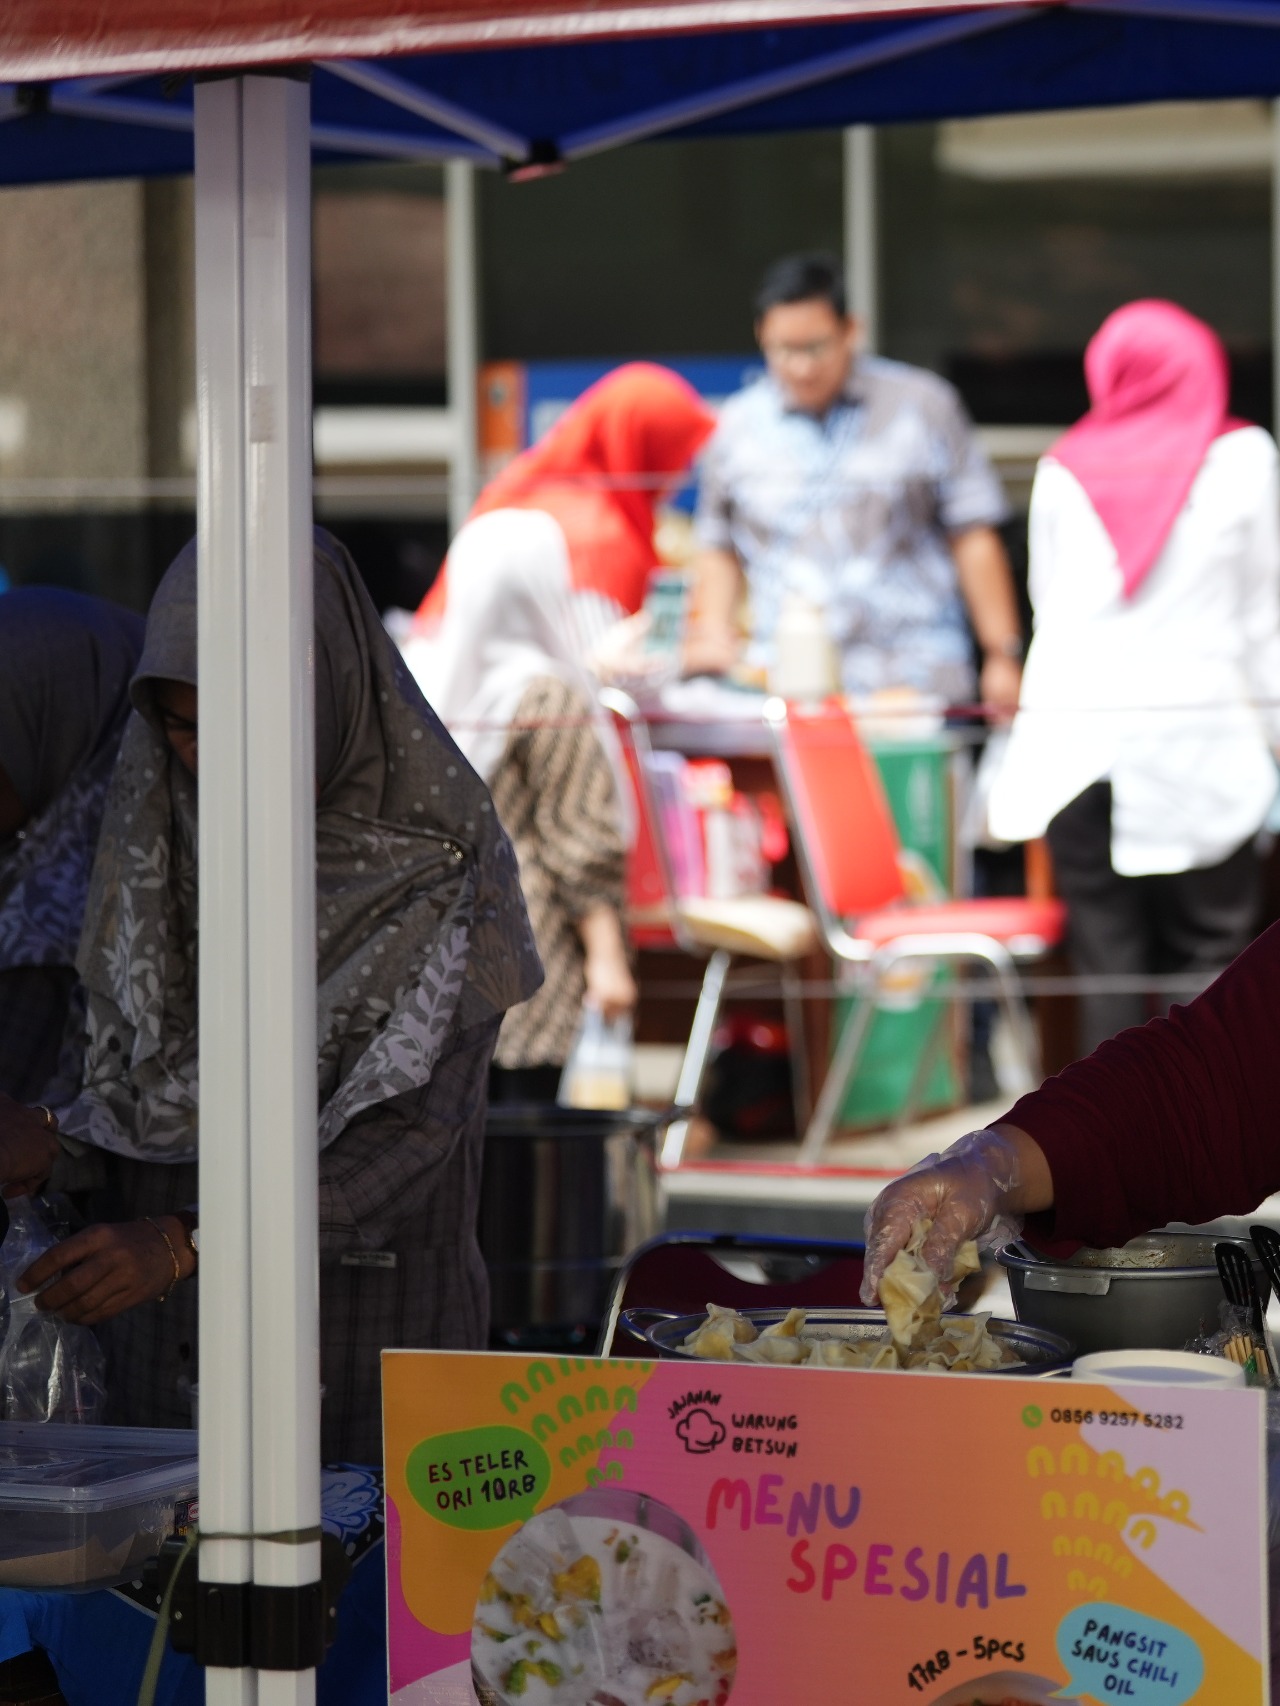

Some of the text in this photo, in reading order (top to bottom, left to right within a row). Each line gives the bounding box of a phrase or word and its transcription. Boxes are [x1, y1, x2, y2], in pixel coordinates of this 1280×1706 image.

[667, 1389, 722, 1419] JAJANAN
[731, 1413, 798, 1431] WARUNG
[1050, 1408, 1184, 1430] 0856 9257 5282
[731, 1436, 798, 1458] BETSUN
[428, 1449, 529, 1484] ES TELER
[436, 1474, 536, 1511] ORI 10RB
[705, 1474, 861, 1537] MENU
[786, 1539, 1027, 1609] SPESIAL
[1083, 1618, 1168, 1659] PANGSIT
[907, 1649, 951, 1692] 17RB
[973, 1635, 1026, 1662] 5PCS
[1071, 1640, 1179, 1688] SAUS CHILI
[1104, 1674, 1135, 1696] OIL
